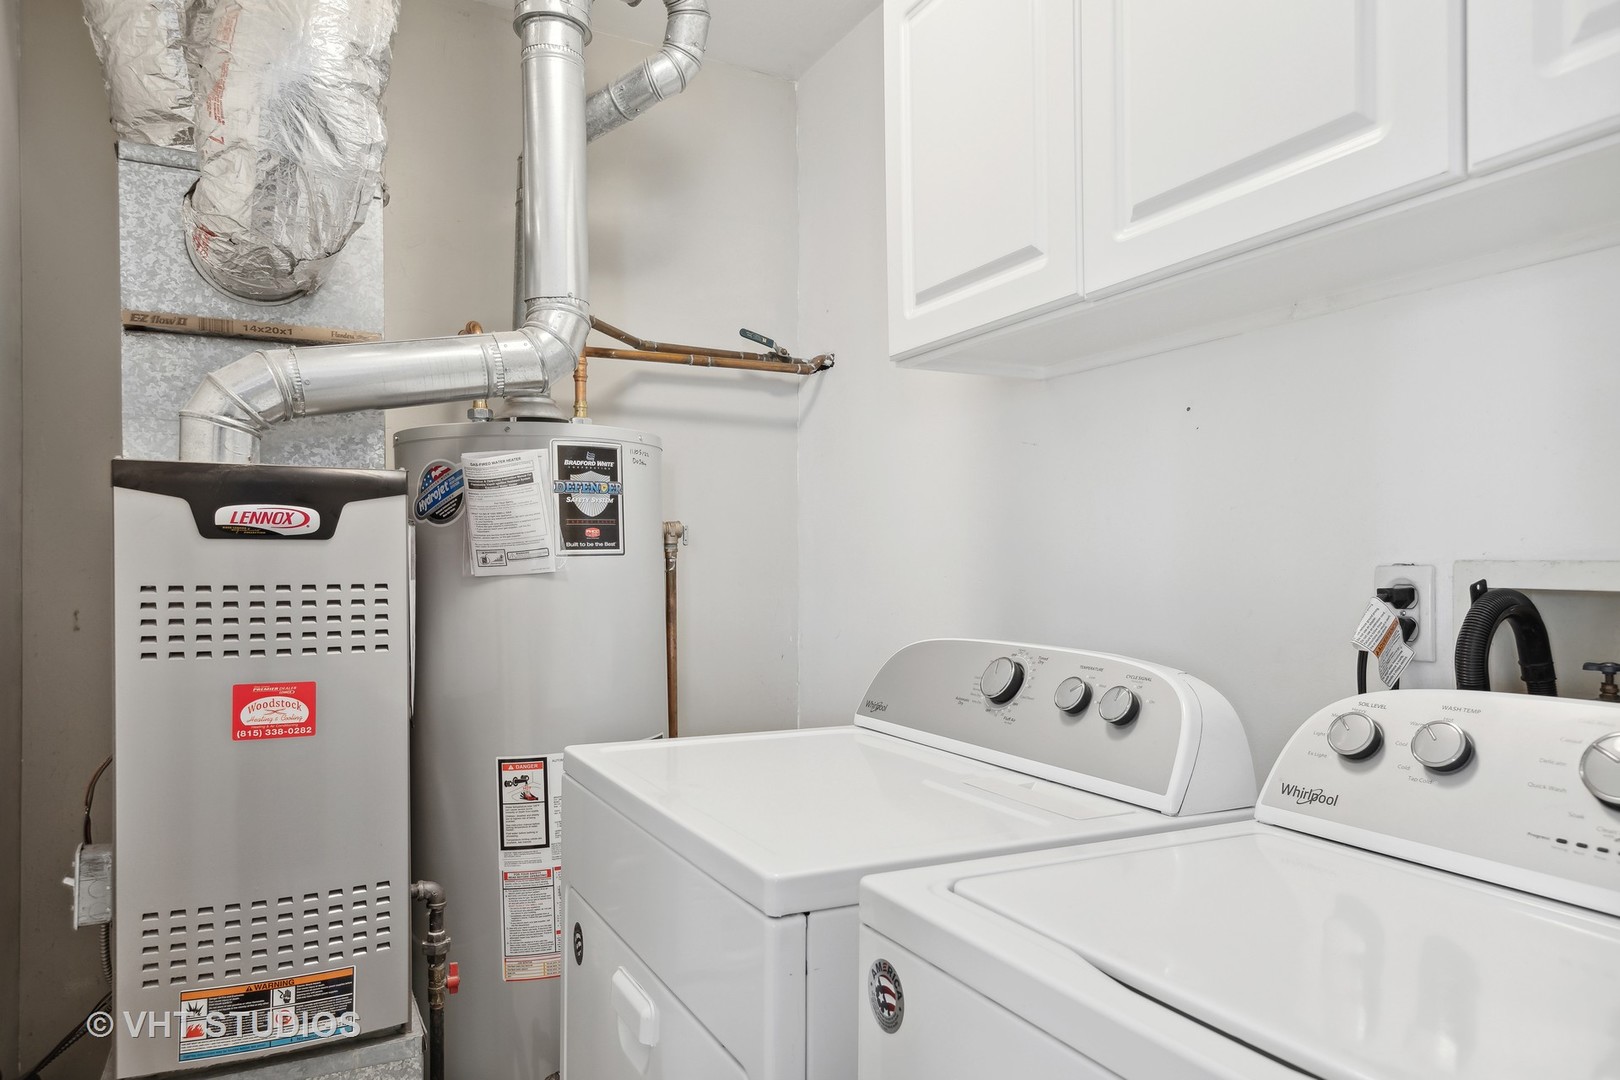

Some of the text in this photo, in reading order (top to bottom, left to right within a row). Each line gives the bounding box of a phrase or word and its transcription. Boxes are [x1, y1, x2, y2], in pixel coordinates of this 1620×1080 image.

[242, 324, 293, 336] 14x20x1
[554, 480, 623, 495] DEFENDER
[418, 480, 450, 513] Hydrojet
[230, 510, 295, 525] LENNOX
[247, 698, 302, 714] Woodstock
[236, 726, 312, 739] (815) 338-0282
[1281, 782, 1339, 806] Whirlpool
[254, 979, 295, 990] WARNING
[871, 961, 903, 1000] AMERICA
